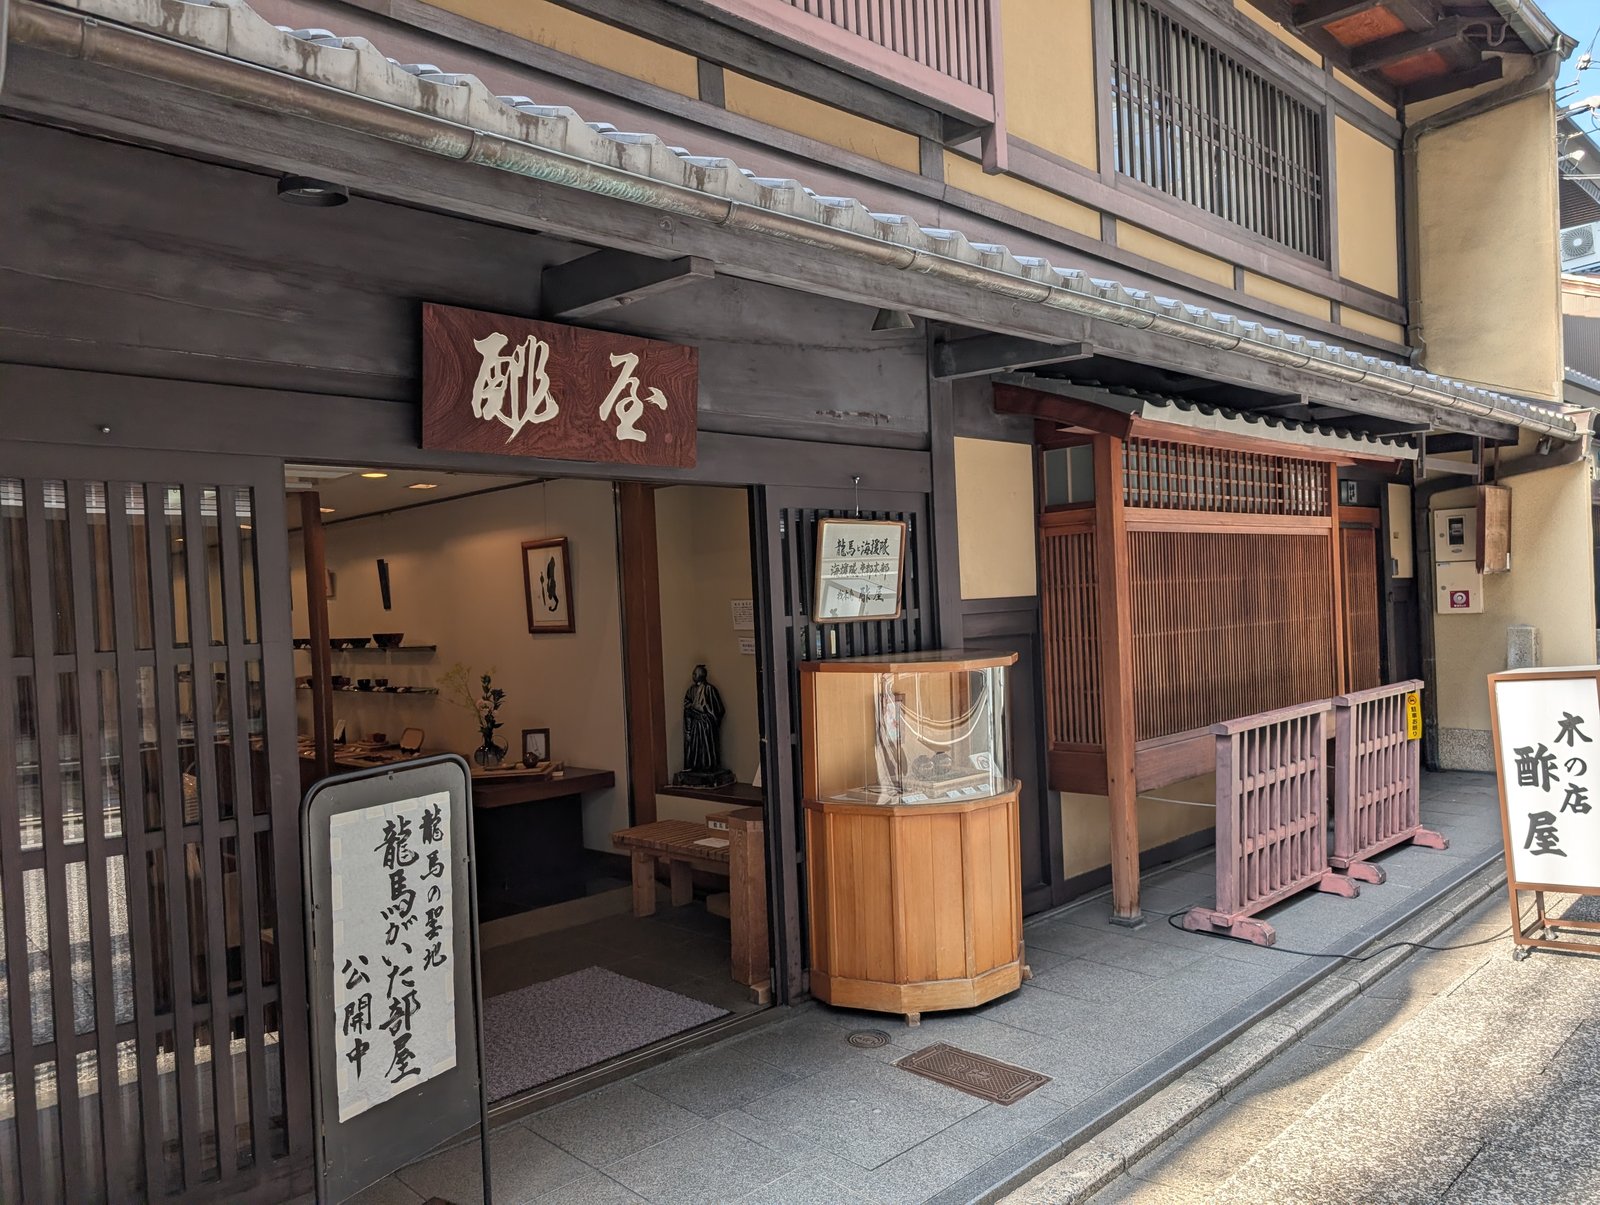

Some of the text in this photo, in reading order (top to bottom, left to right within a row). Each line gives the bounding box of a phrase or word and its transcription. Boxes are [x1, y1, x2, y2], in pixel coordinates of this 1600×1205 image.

[1513, 742, 1568, 857] 酢屋
[1553, 711, 1593, 814] 木の店
[374, 815, 422, 1083] 龍馬がいた部屋
[418, 803, 448, 971] 龍馬の聖地
[341, 955, 373, 1082] 公開中
